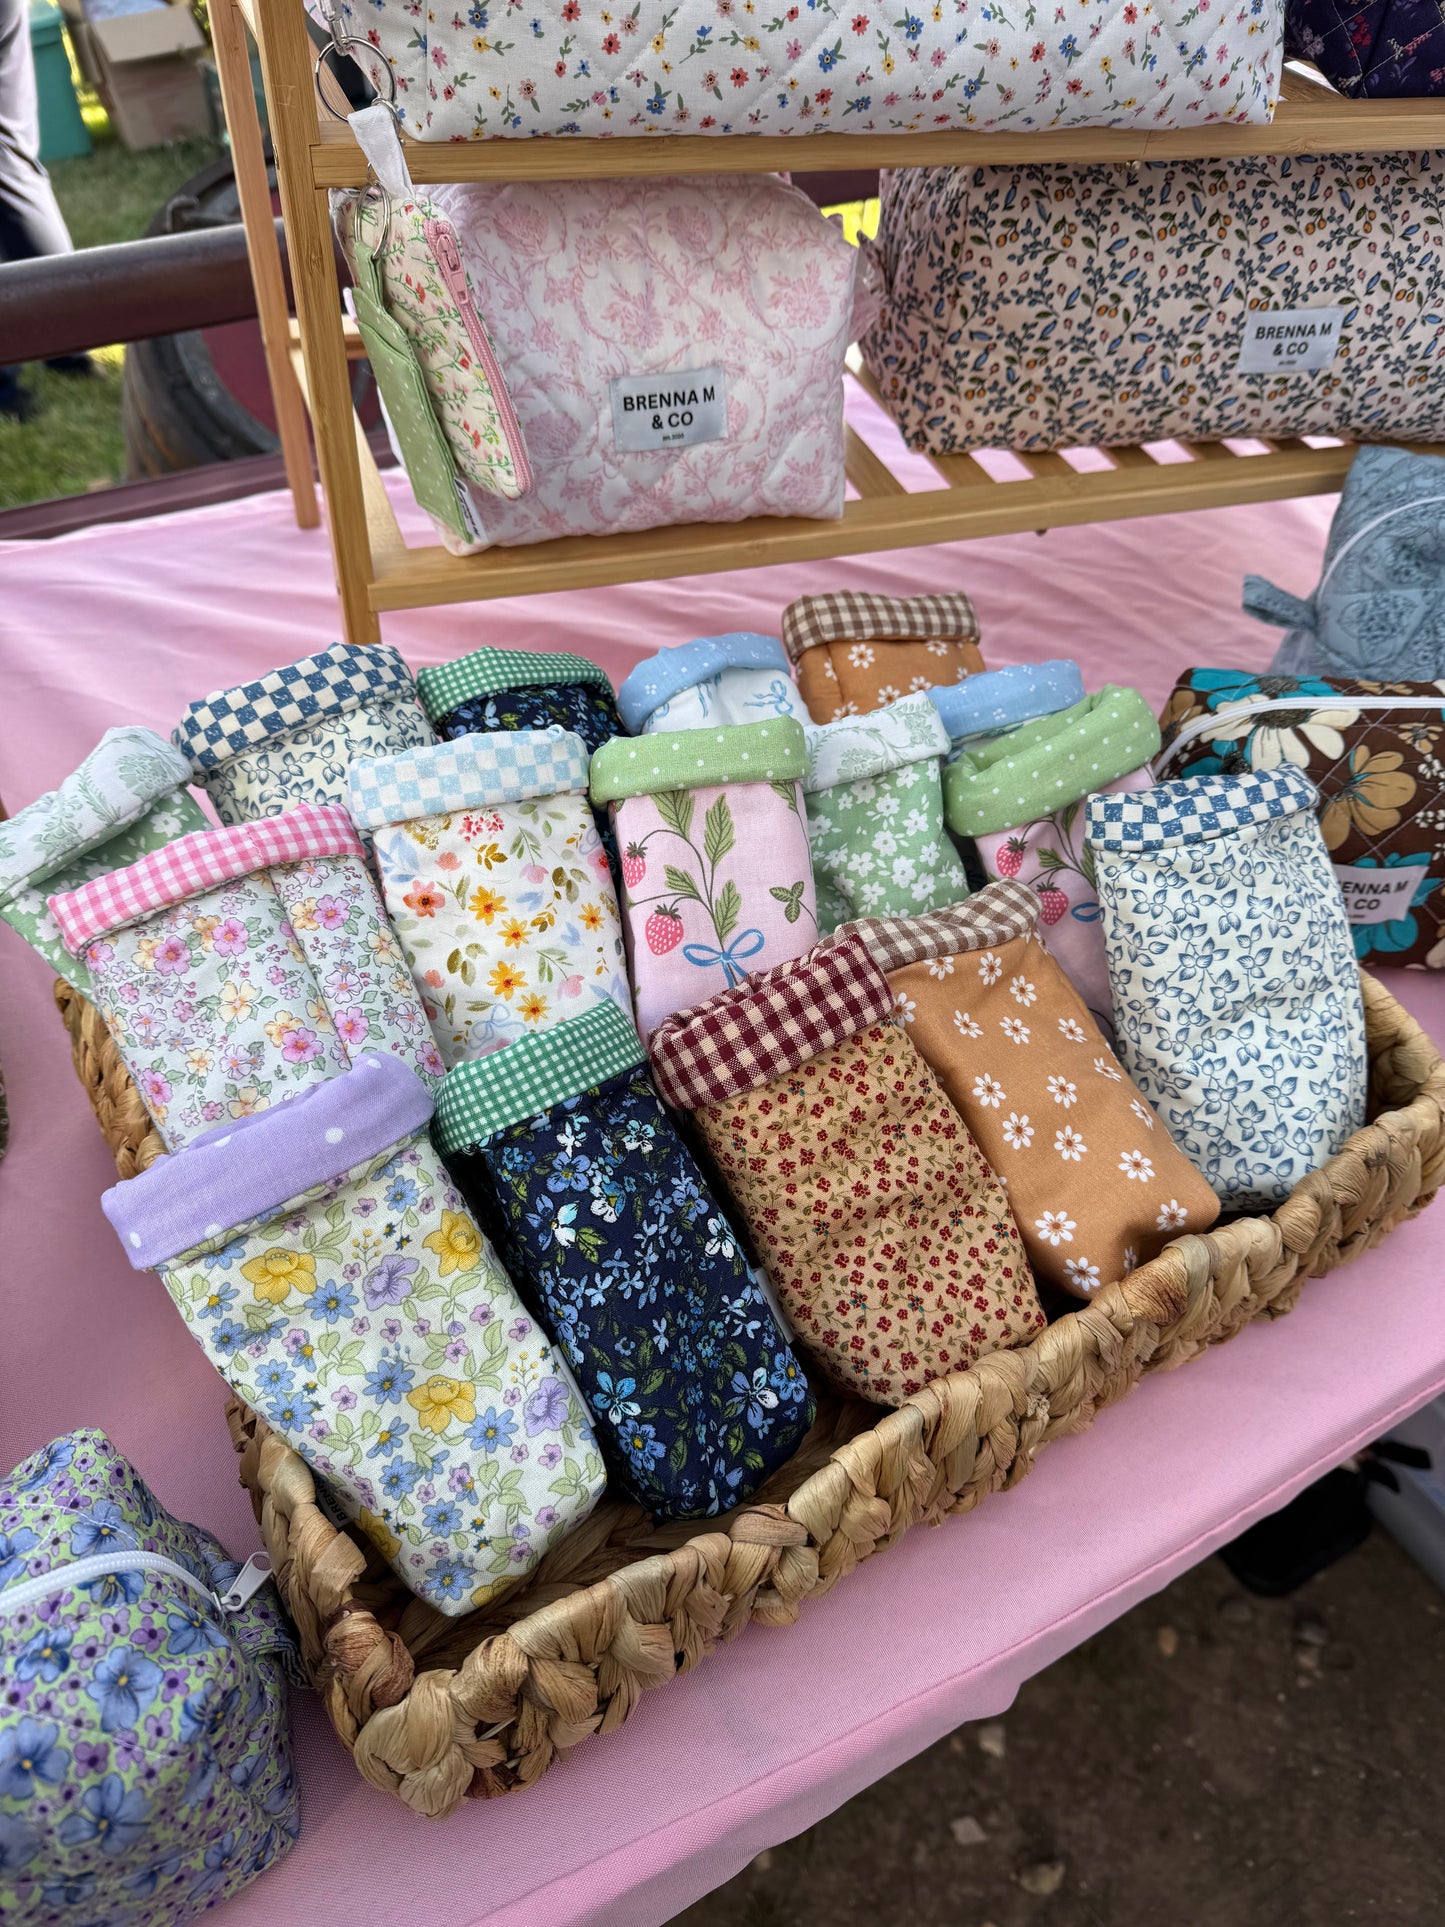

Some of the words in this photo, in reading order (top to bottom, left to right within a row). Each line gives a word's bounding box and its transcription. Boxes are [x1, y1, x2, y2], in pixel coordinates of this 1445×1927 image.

[1255, 324, 1316, 339] BRENNA
[1319, 322, 1332, 336] M
[1273, 343, 1282, 356] &
[1286, 342, 1308, 355] CO
[623, 389, 699, 411] BRENNA
[703, 385, 715, 403] M
[652, 414, 663, 430] &
[668, 411, 693, 428] CO
[1338, 881, 1390, 895] ENNA
[1394, 880, 1409, 893] M
[1354, 898, 1380, 910] CO
